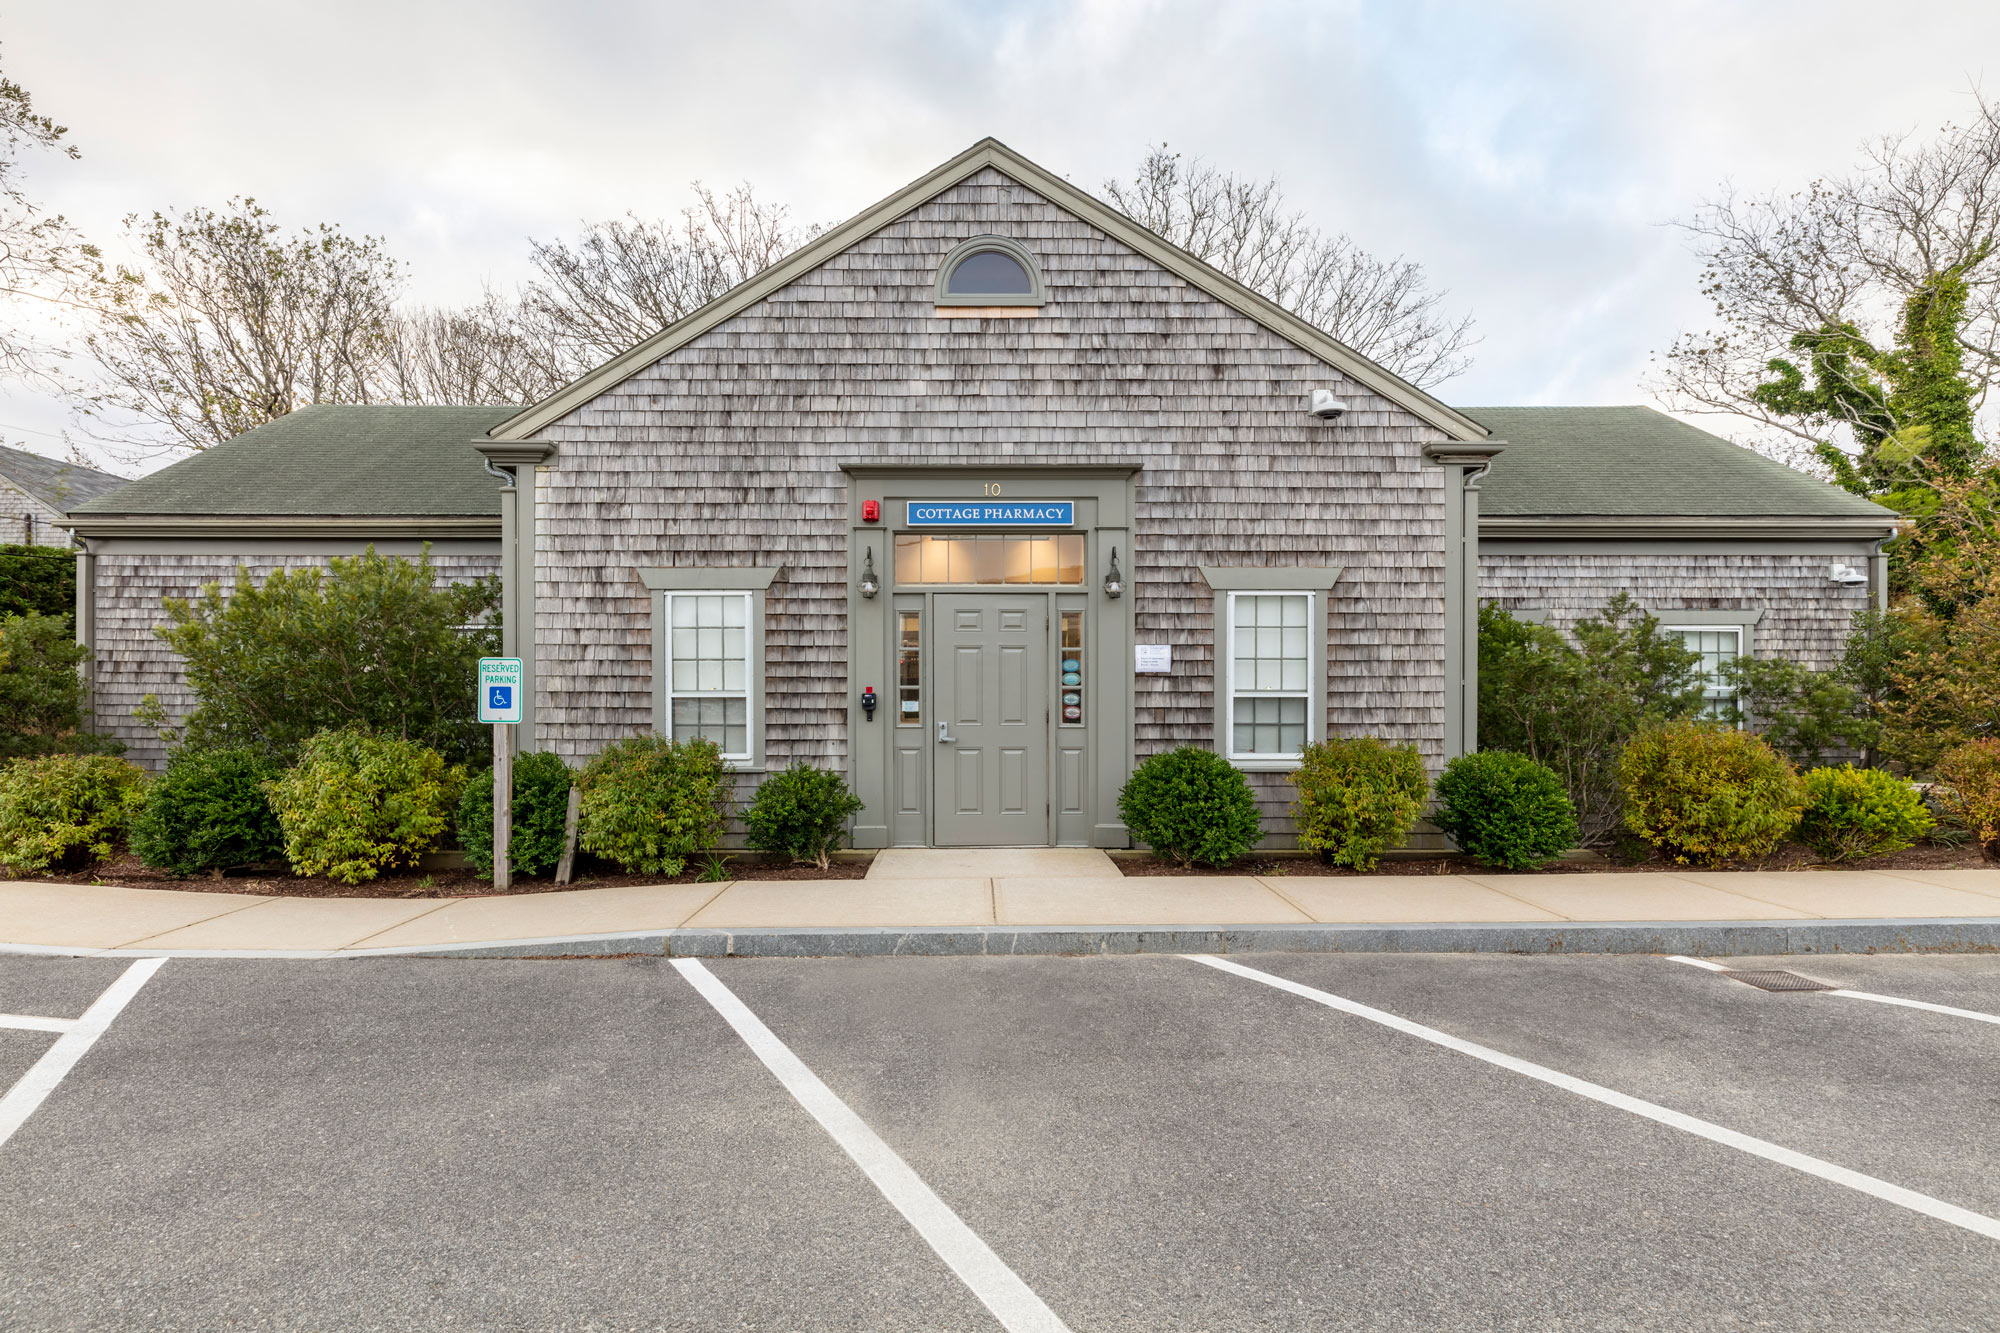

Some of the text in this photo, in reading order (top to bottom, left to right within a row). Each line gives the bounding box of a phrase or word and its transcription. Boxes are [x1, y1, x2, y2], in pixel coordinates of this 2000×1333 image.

[983, 482, 1001, 497] 10
[916, 508, 1065, 519] COTTAGE PHARMACY
[482, 664, 519, 673] RESERVED
[485, 675, 517, 684] PARKING
